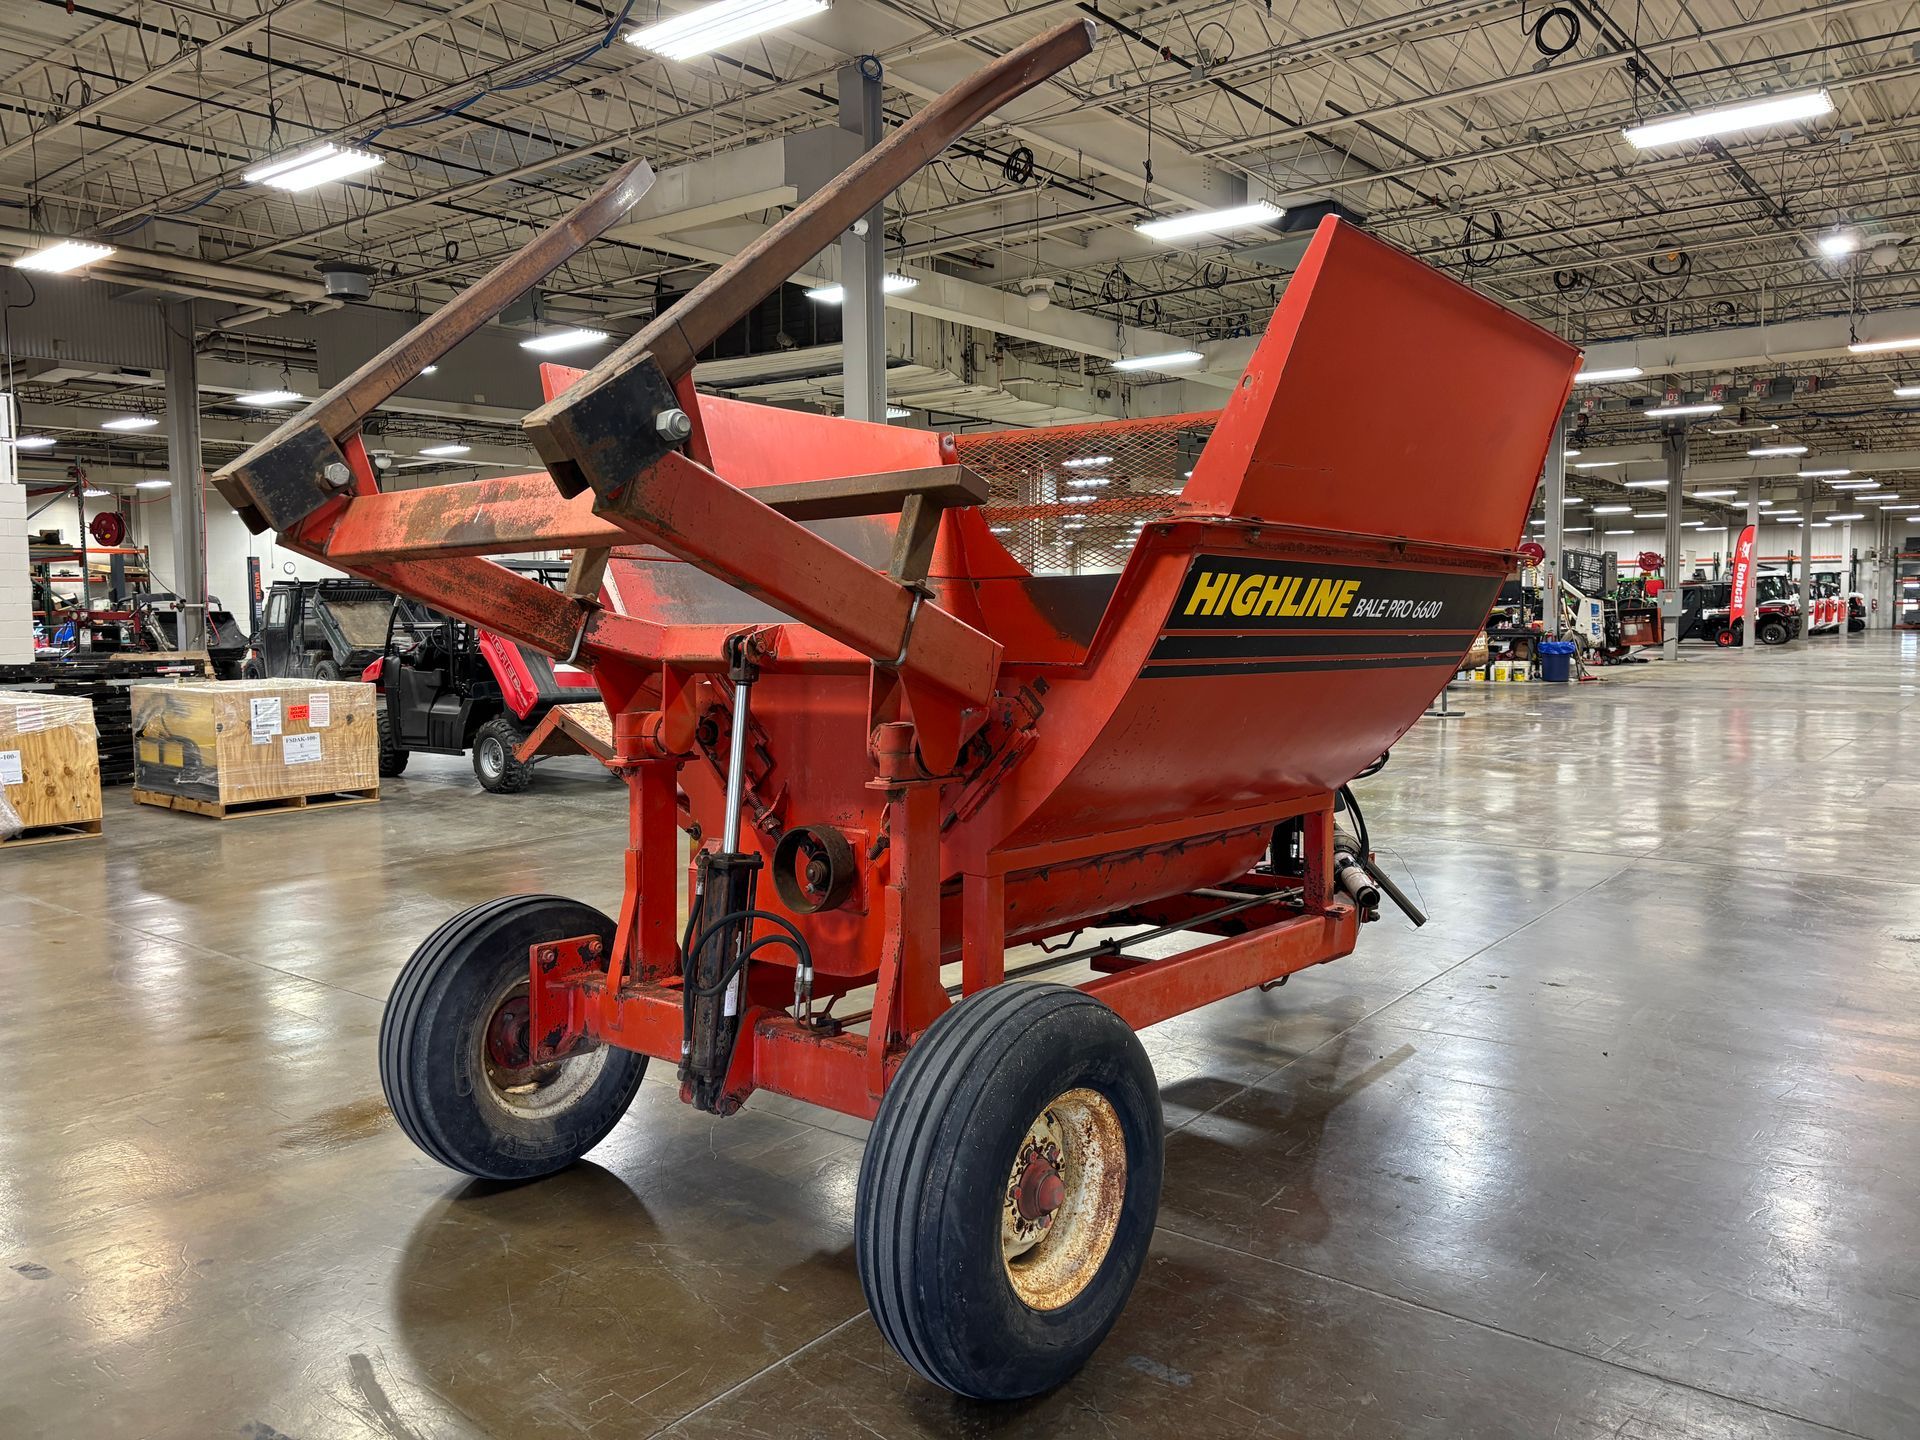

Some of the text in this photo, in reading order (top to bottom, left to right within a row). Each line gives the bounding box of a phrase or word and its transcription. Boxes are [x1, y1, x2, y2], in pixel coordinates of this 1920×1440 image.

[1183, 572, 1362, 617] HIGHLINE
[1734, 563, 1747, 608] Bobcat
[1352, 598, 1443, 619] BALE PRO 6600
